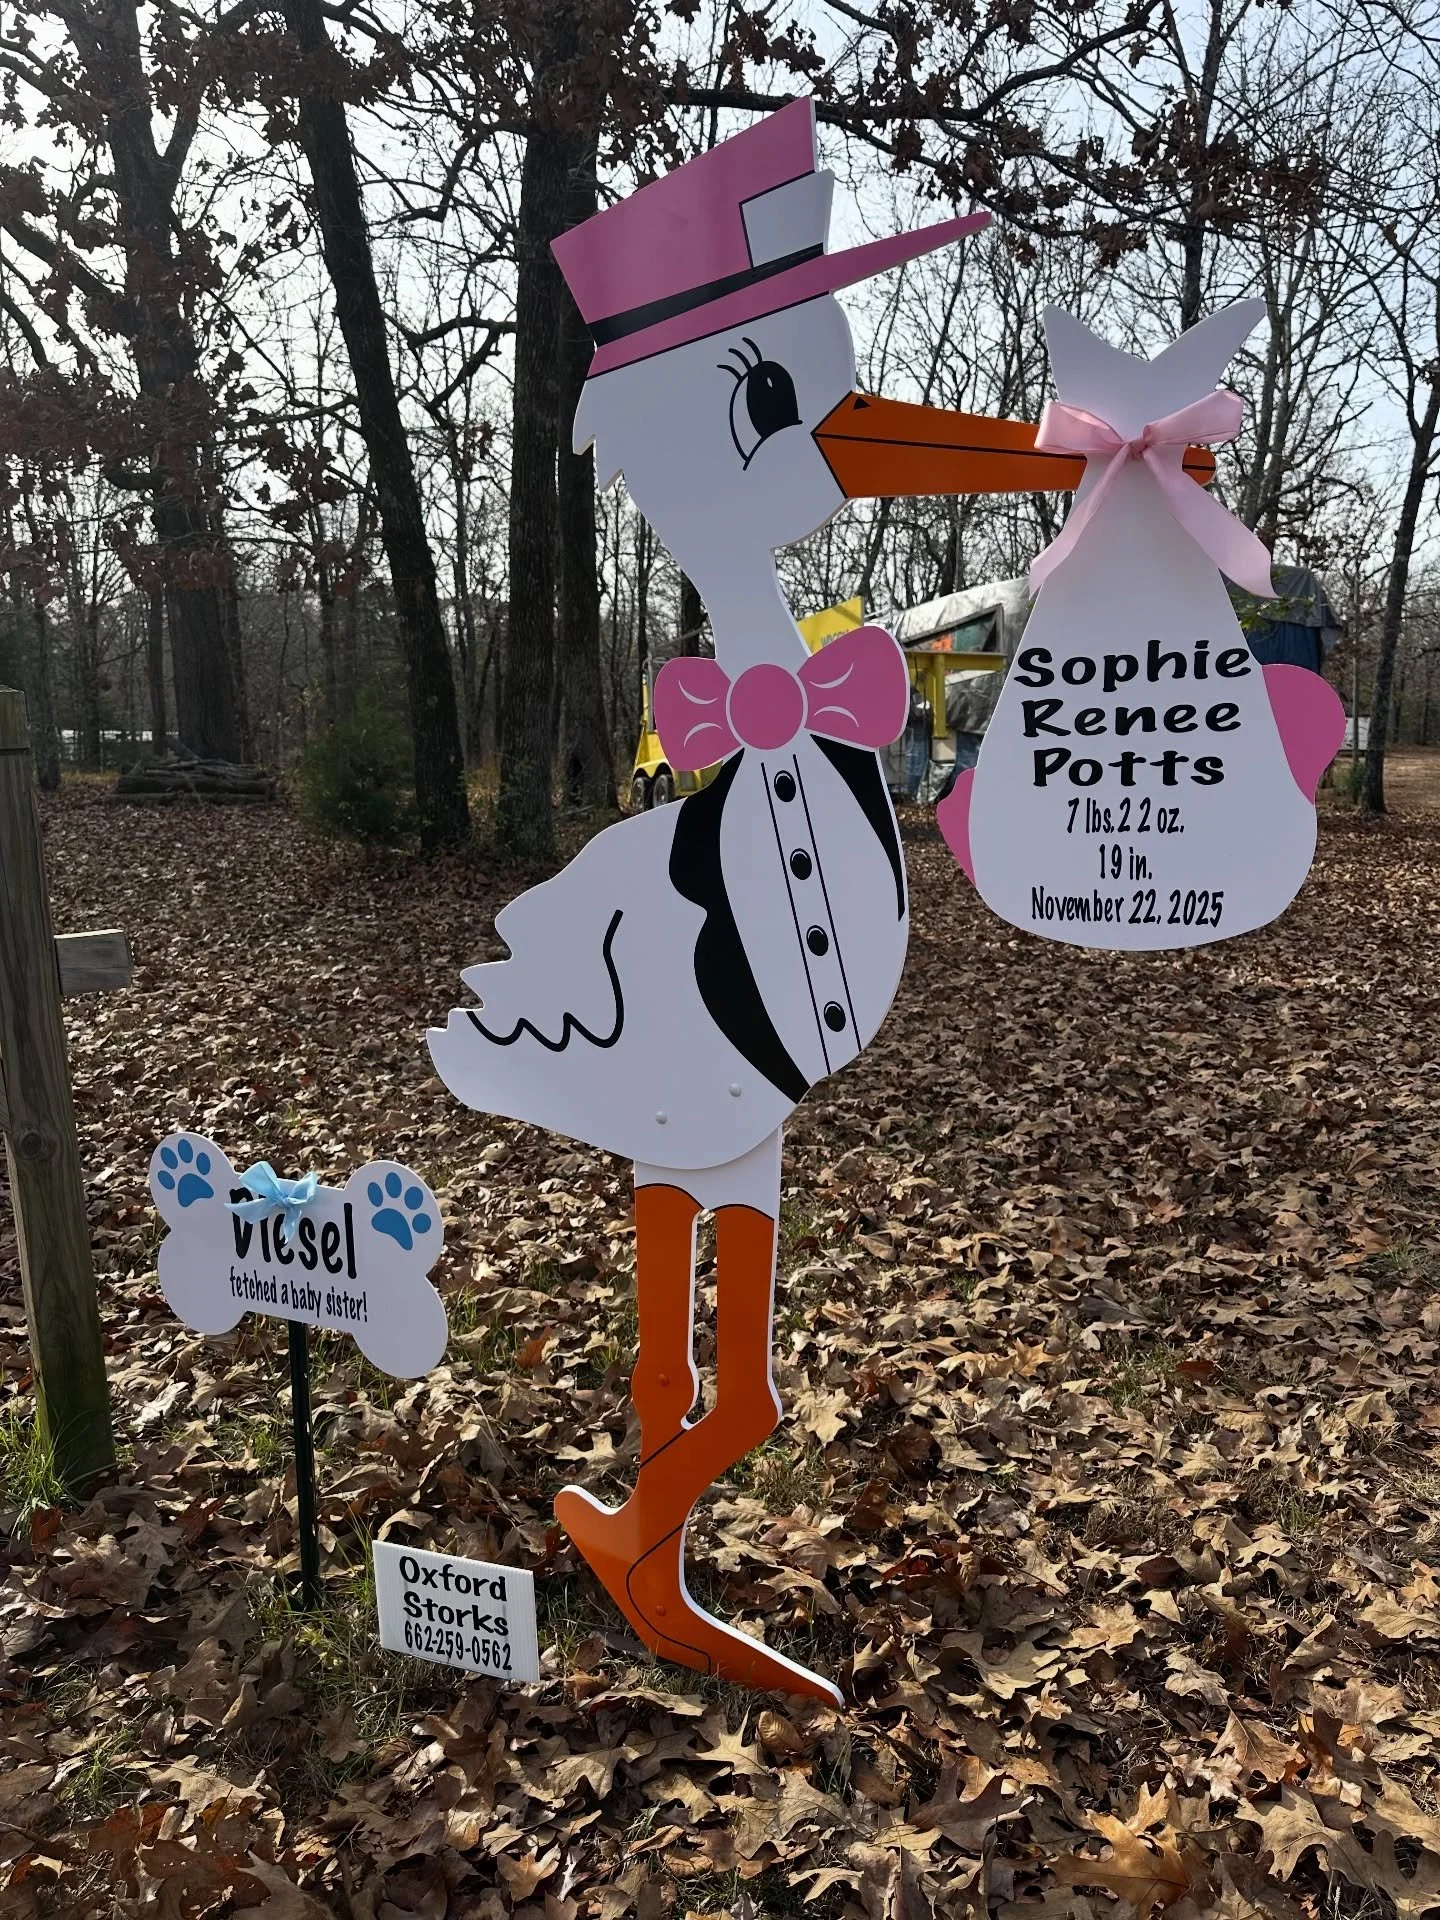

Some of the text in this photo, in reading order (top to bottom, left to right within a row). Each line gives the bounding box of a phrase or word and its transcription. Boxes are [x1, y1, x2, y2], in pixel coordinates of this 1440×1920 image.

[1013, 639, 1252, 693] Sophie
[1021, 698, 1242, 738] Renee
[1032, 747, 1225, 787] Potts
[1066, 797, 1080, 834] 7
[1157, 807, 1185, 834] oz.
[1099, 843, 1153, 881] 19 in.
[1031, 885, 1224, 928] November 22, 2025
[229, 1265, 368, 1323] fetched a baby sister!
[399, 1555, 508, 1602] Oxford
[402, 1590, 509, 1637] Storks
[404, 1620, 513, 1671] 662-259-0562
